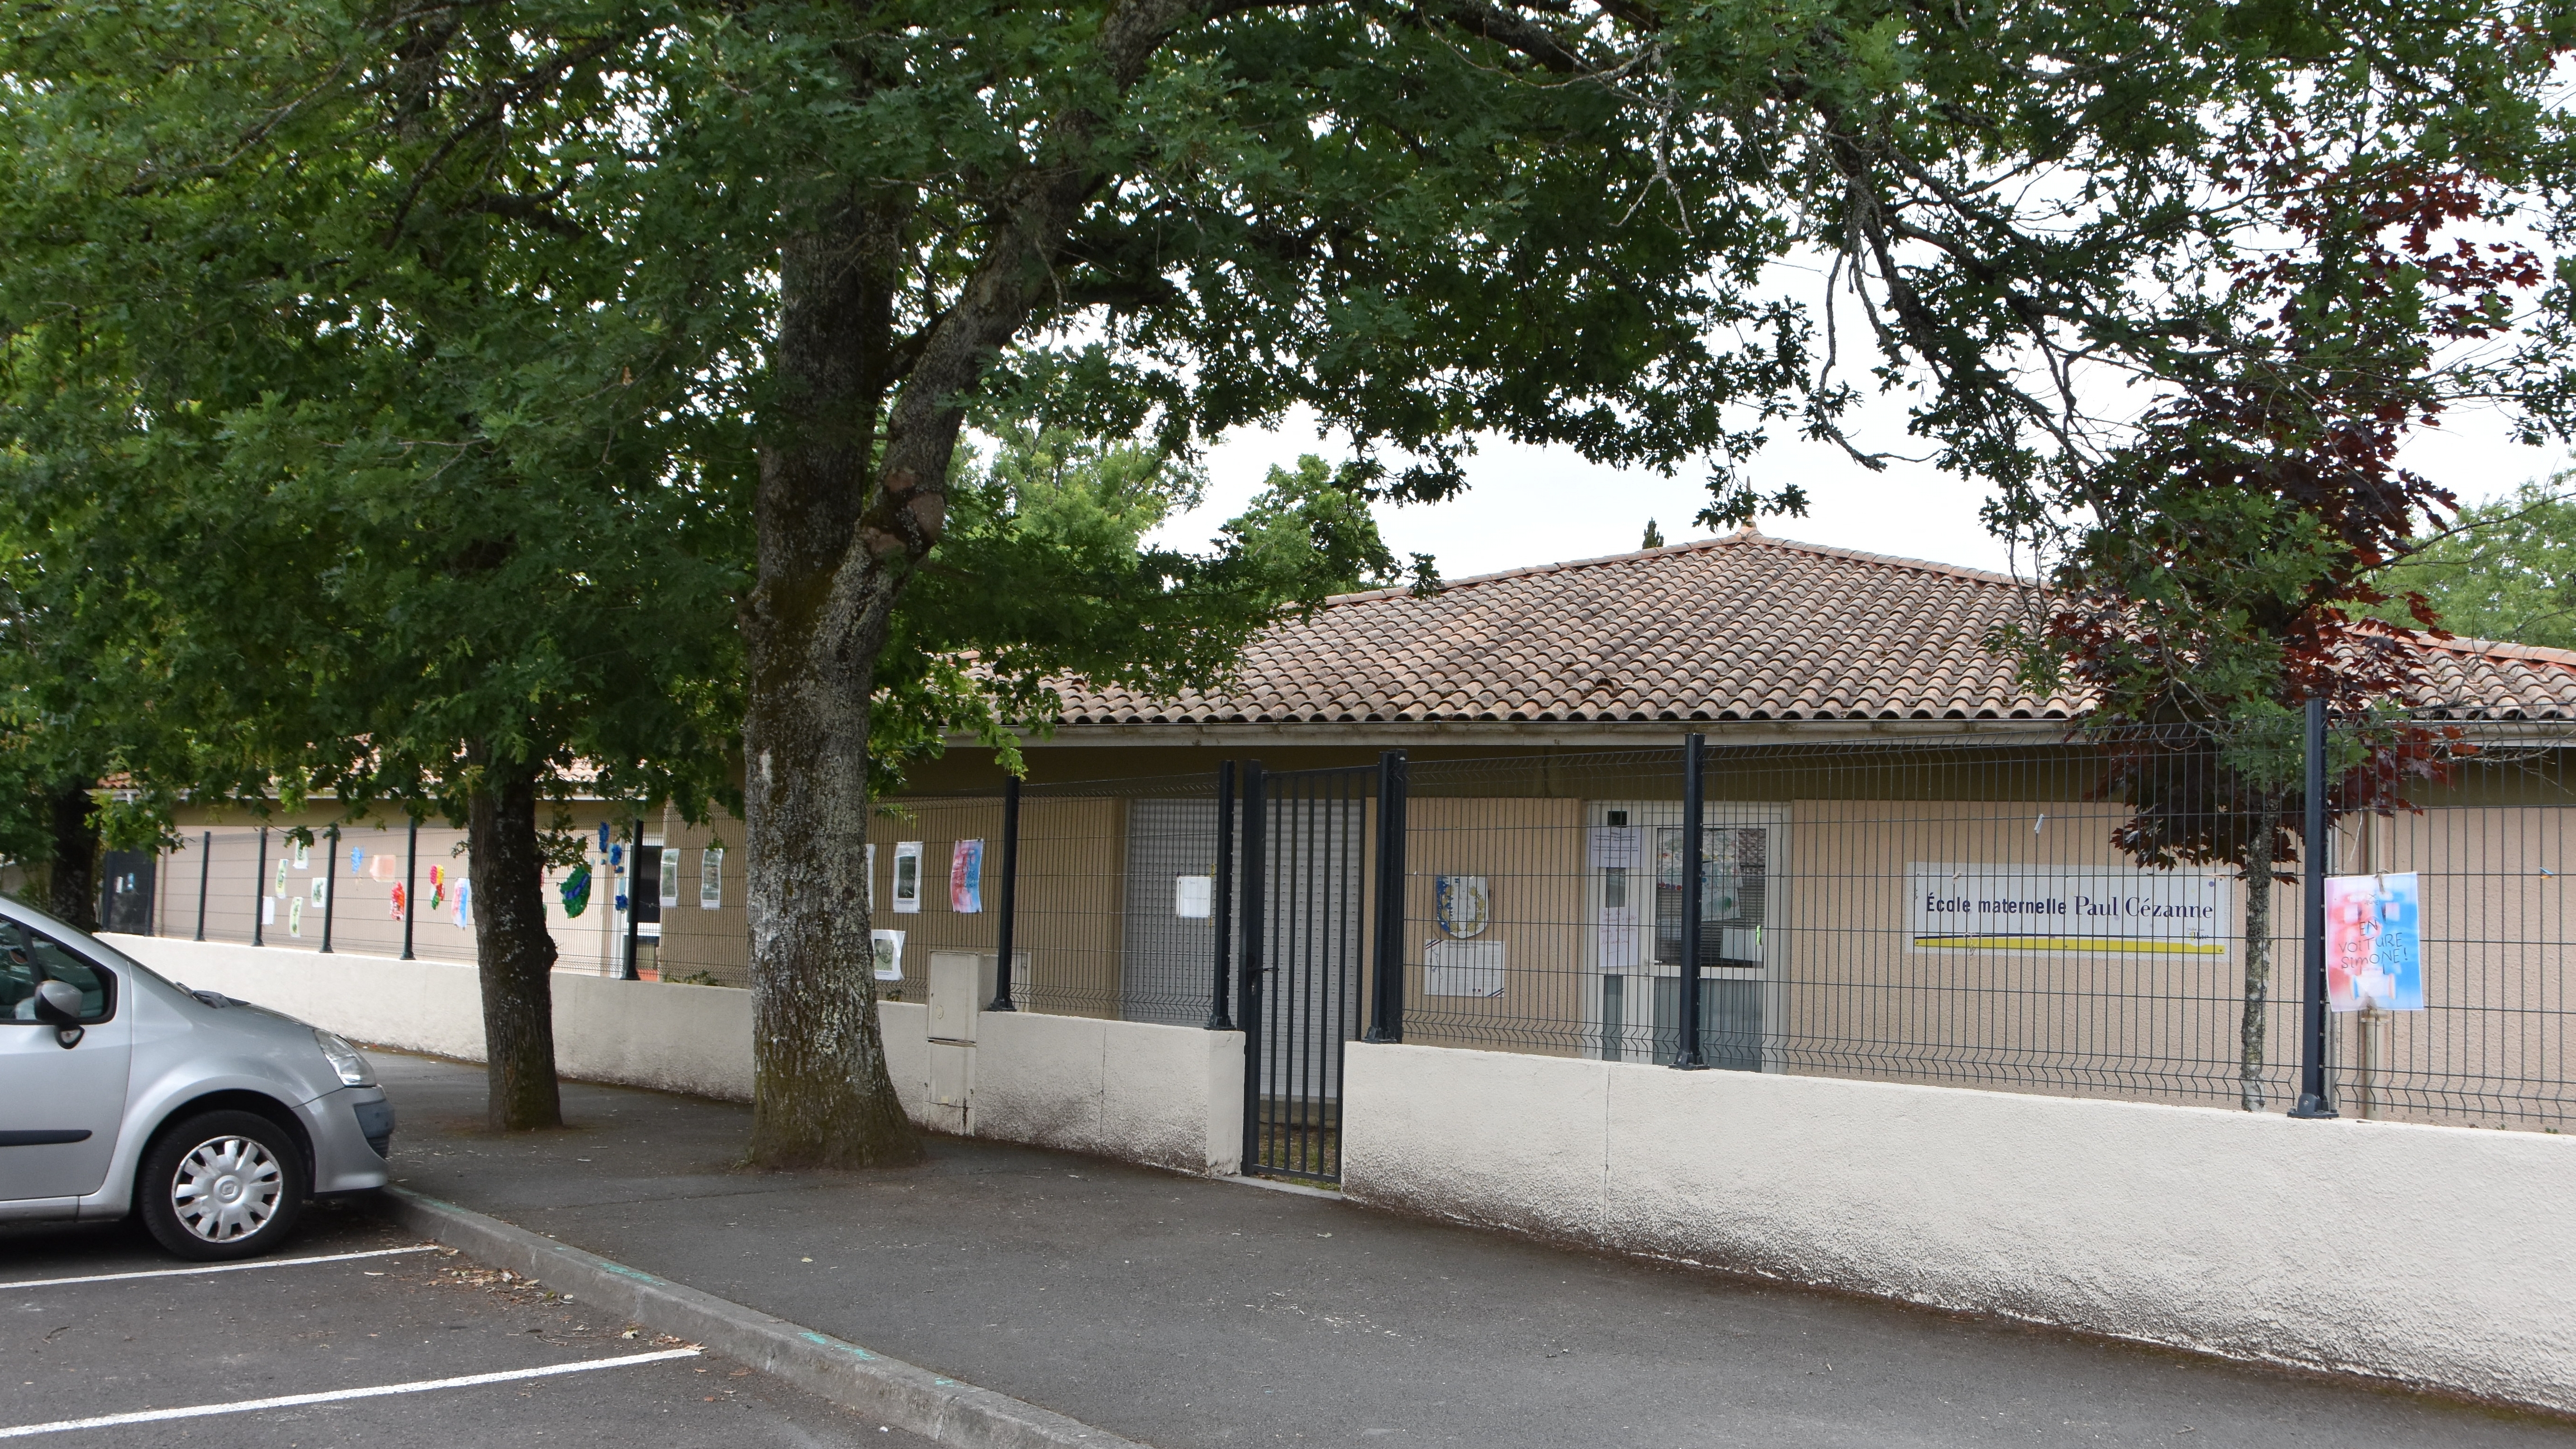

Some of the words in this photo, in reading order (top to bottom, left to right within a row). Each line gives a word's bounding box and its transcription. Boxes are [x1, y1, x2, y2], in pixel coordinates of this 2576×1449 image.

[1927, 892, 1971, 913] École
[1978, 899, 2066, 914] maternelle
[2074, 896, 2118, 916] Paul
[2125, 896, 2213, 918] Cézanne
[2359, 919, 2378, 936] EN
